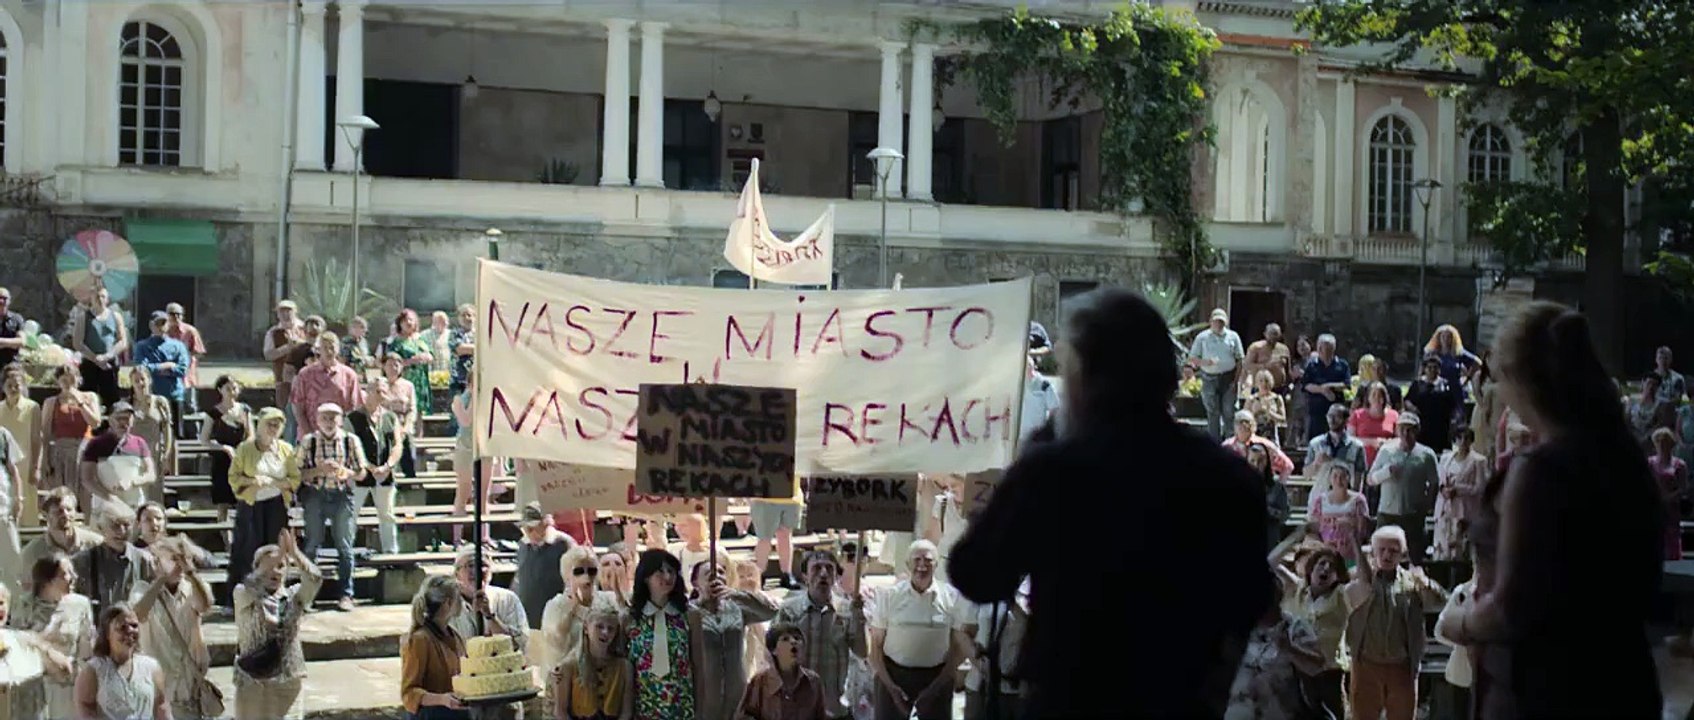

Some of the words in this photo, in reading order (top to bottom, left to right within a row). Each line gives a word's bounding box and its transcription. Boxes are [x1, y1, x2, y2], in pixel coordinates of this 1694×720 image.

[488, 299, 695, 363] NASZE
[647, 385, 789, 421] NASZE
[680, 413, 787, 444] MIASTO
[822, 397, 1013, 446] REKACH
[638, 427, 672, 455] W
[649, 468, 770, 498] REKACH
